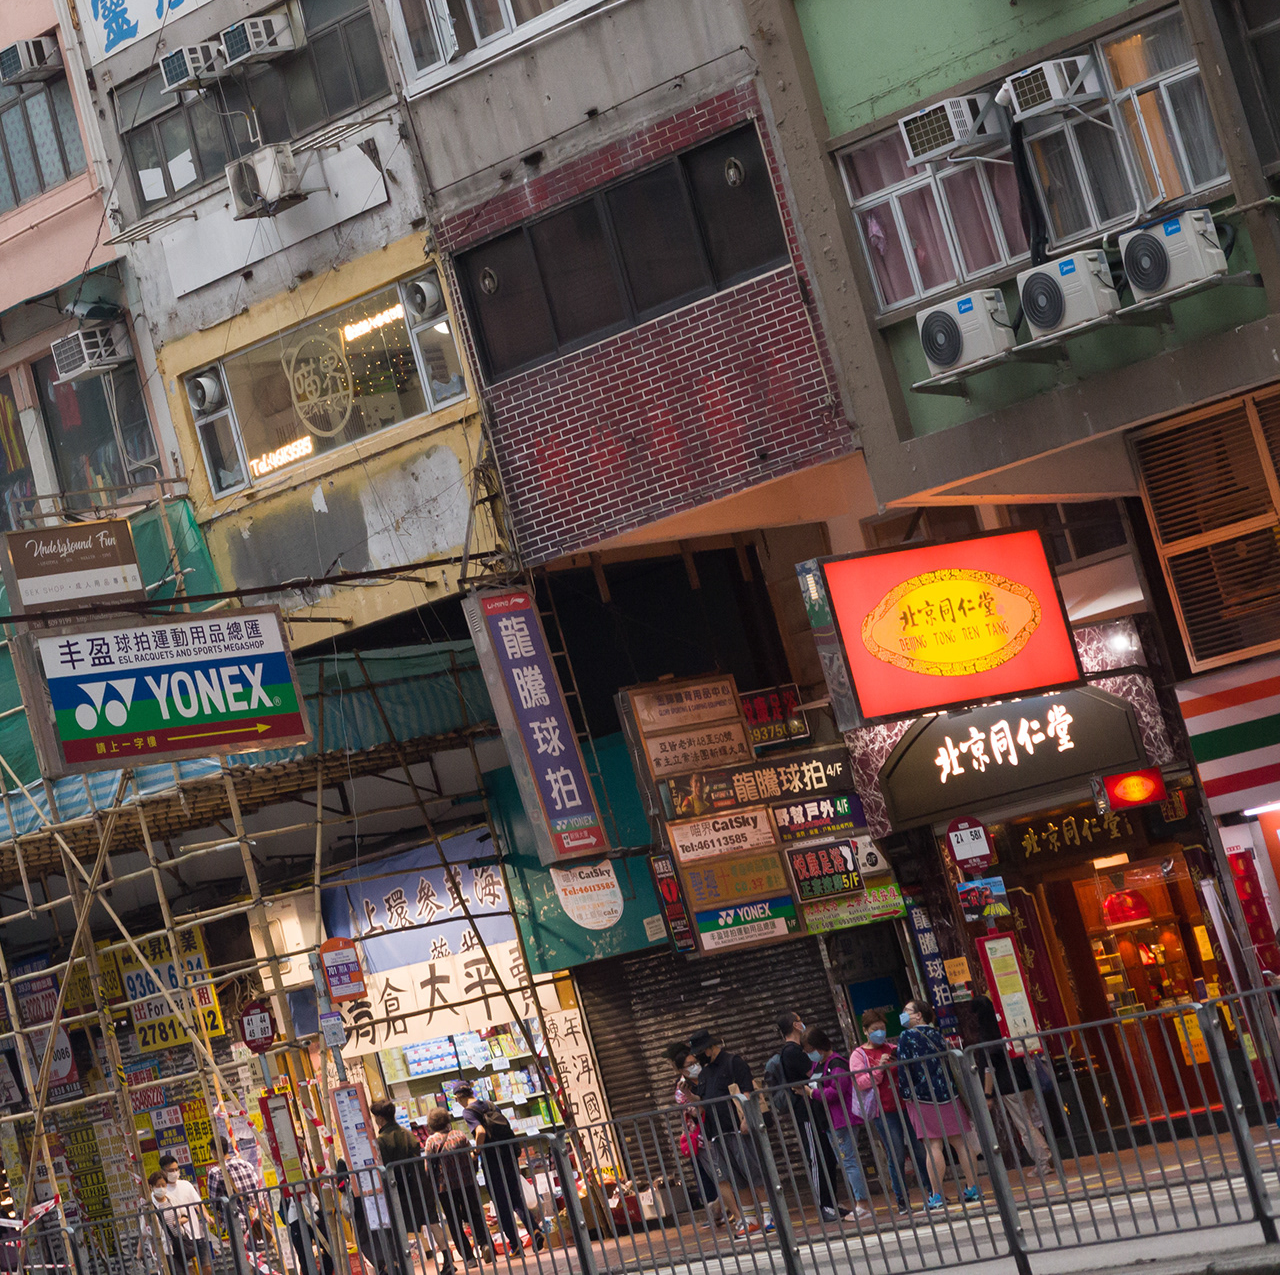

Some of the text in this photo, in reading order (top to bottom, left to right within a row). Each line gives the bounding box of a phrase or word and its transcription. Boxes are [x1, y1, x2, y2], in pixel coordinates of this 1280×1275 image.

[25, 530, 116, 557] Underground Fun
[43, 585, 65, 594] SHOP
[899, 591, 995, 631] 北京同仁堂
[113, 619, 263, 654] 球拍運動用品總匯
[899, 620, 1009, 652] BEIJING TONG REN TANG
[118, 640, 265, 665] ESL RACQUETS AND SPORTS MEGASHOP
[144, 663, 273, 720] YONEX
[498, 616, 582, 810] 龍騰球拍
[934, 704, 1075, 783] 北京同仁堂
[731, 759, 843, 803] 龍騰球拍 4/F
[835, 798, 848, 814] 4/F
[568, 815, 594, 827] YONEX
[679, 833, 748, 854] Tel:46113585
[954, 830, 982, 843] 2A 58X
[1022, 811, 1122, 857] 北京同仁堂
[562, 882, 615, 896] Tel:46113585
[842, 872, 860, 889] 5/F
[736, 902, 772, 921] YONEX
[327, 966, 337, 976] 701
[147, 1002, 165, 1018] For
[197, 986, 212, 1006] 租
[247, 1015, 267, 1026] 41 44
[248, 1026, 270, 1038] 45 887
